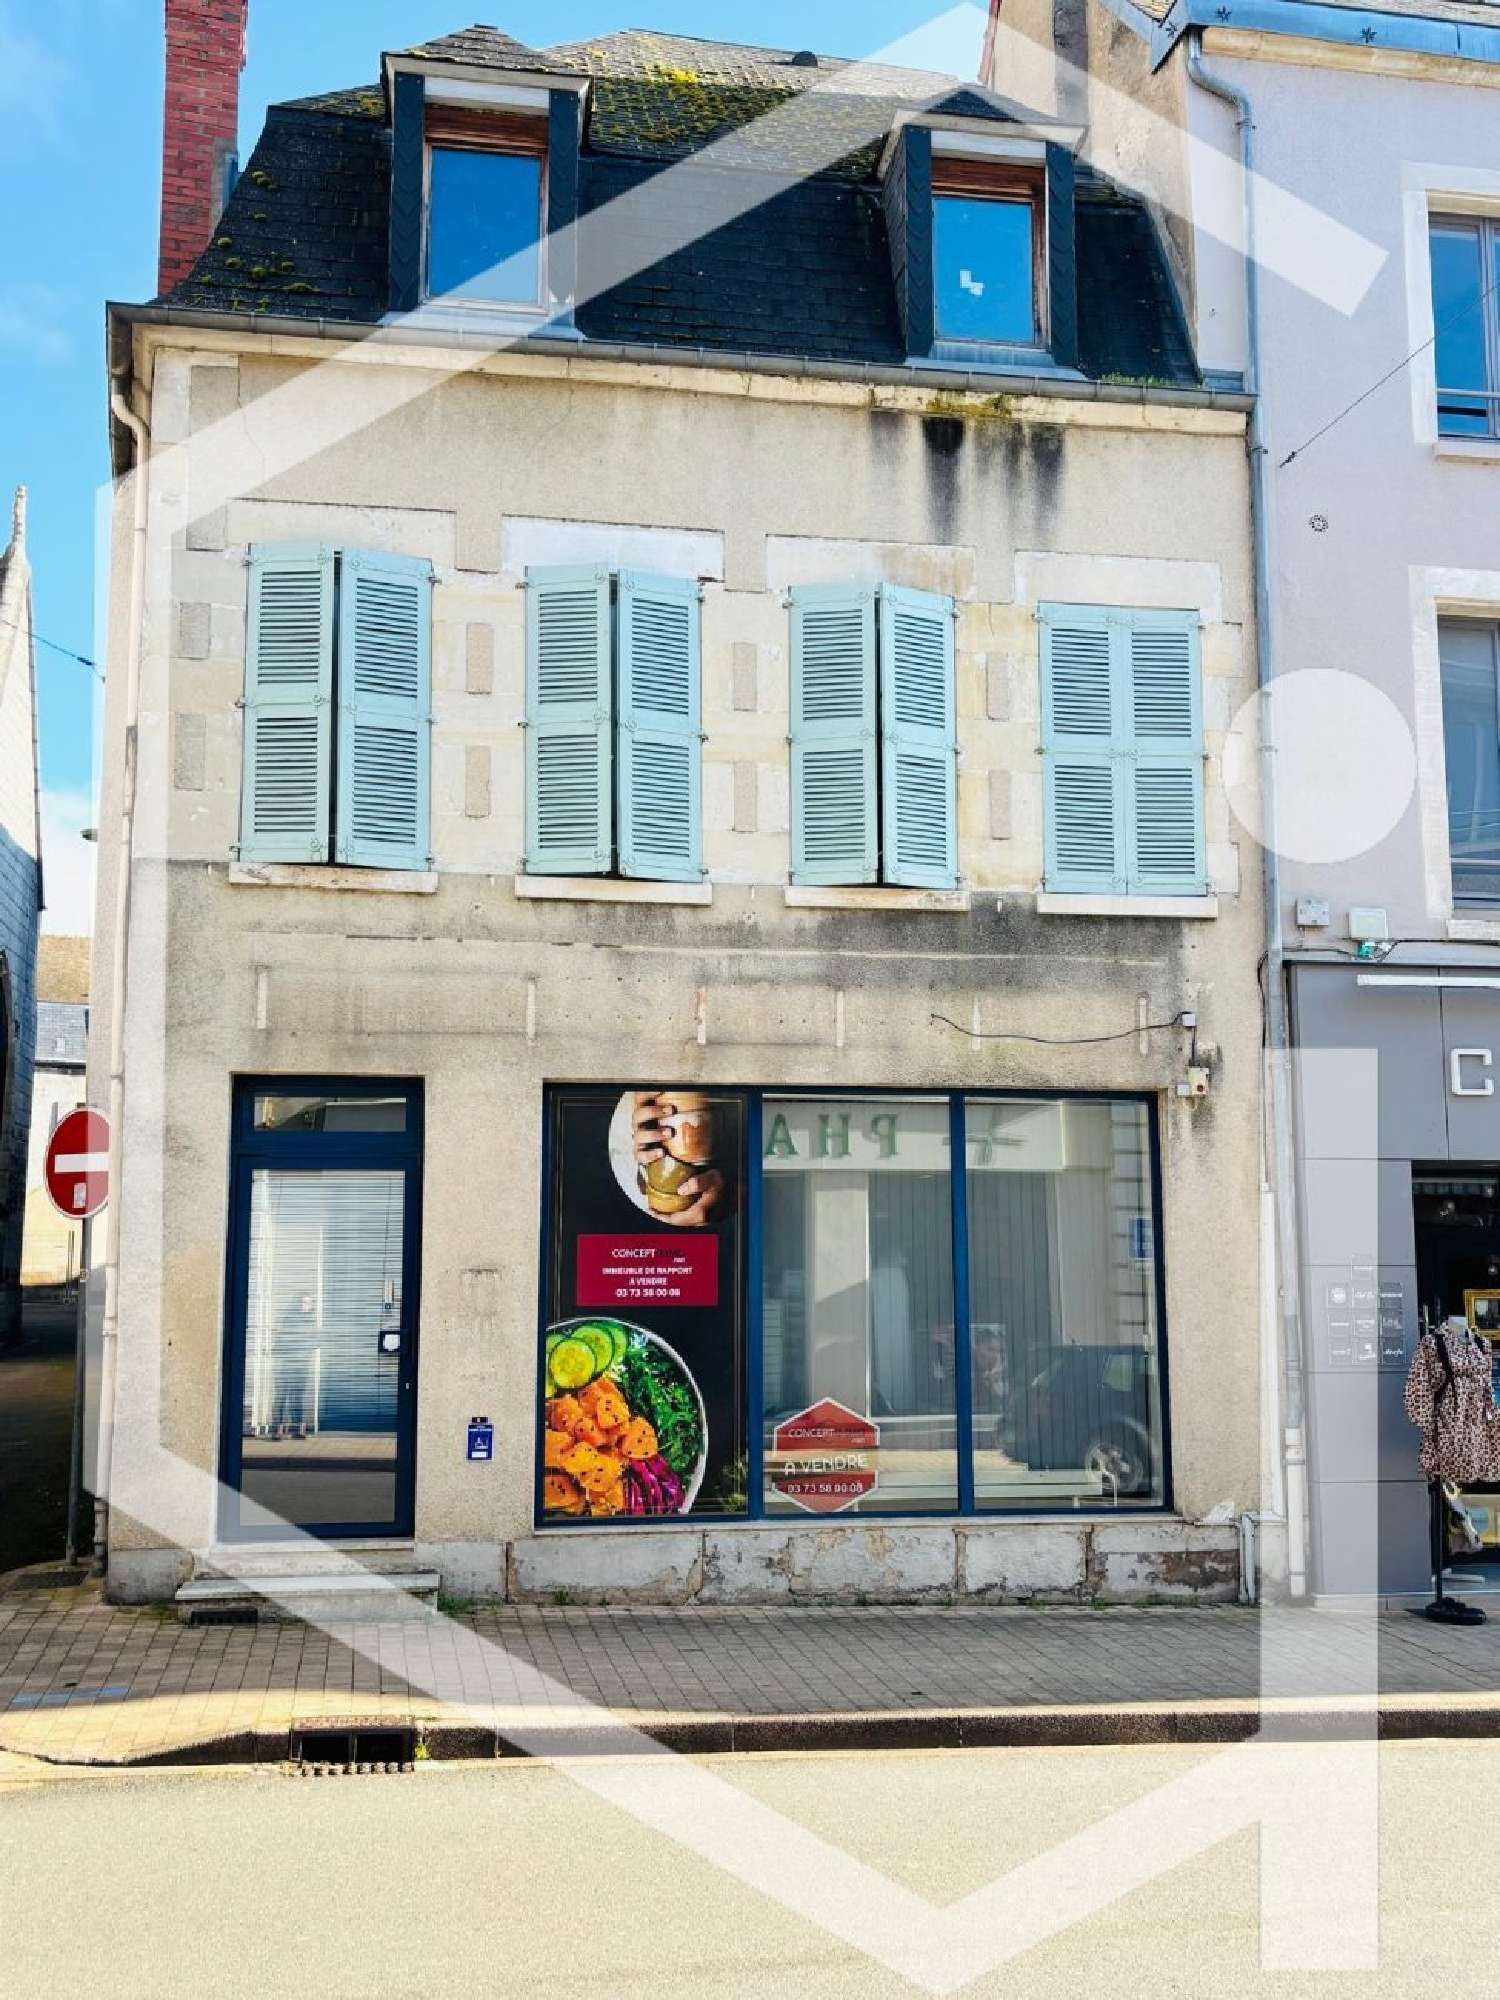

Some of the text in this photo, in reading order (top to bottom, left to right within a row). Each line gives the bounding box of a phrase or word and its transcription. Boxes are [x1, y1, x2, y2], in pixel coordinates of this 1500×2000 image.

[636, 1277, 667, 1286] VENDRE
[788, 1428, 835, 1438] CONCEPT
[799, 1453, 869, 1473] VENDRE
